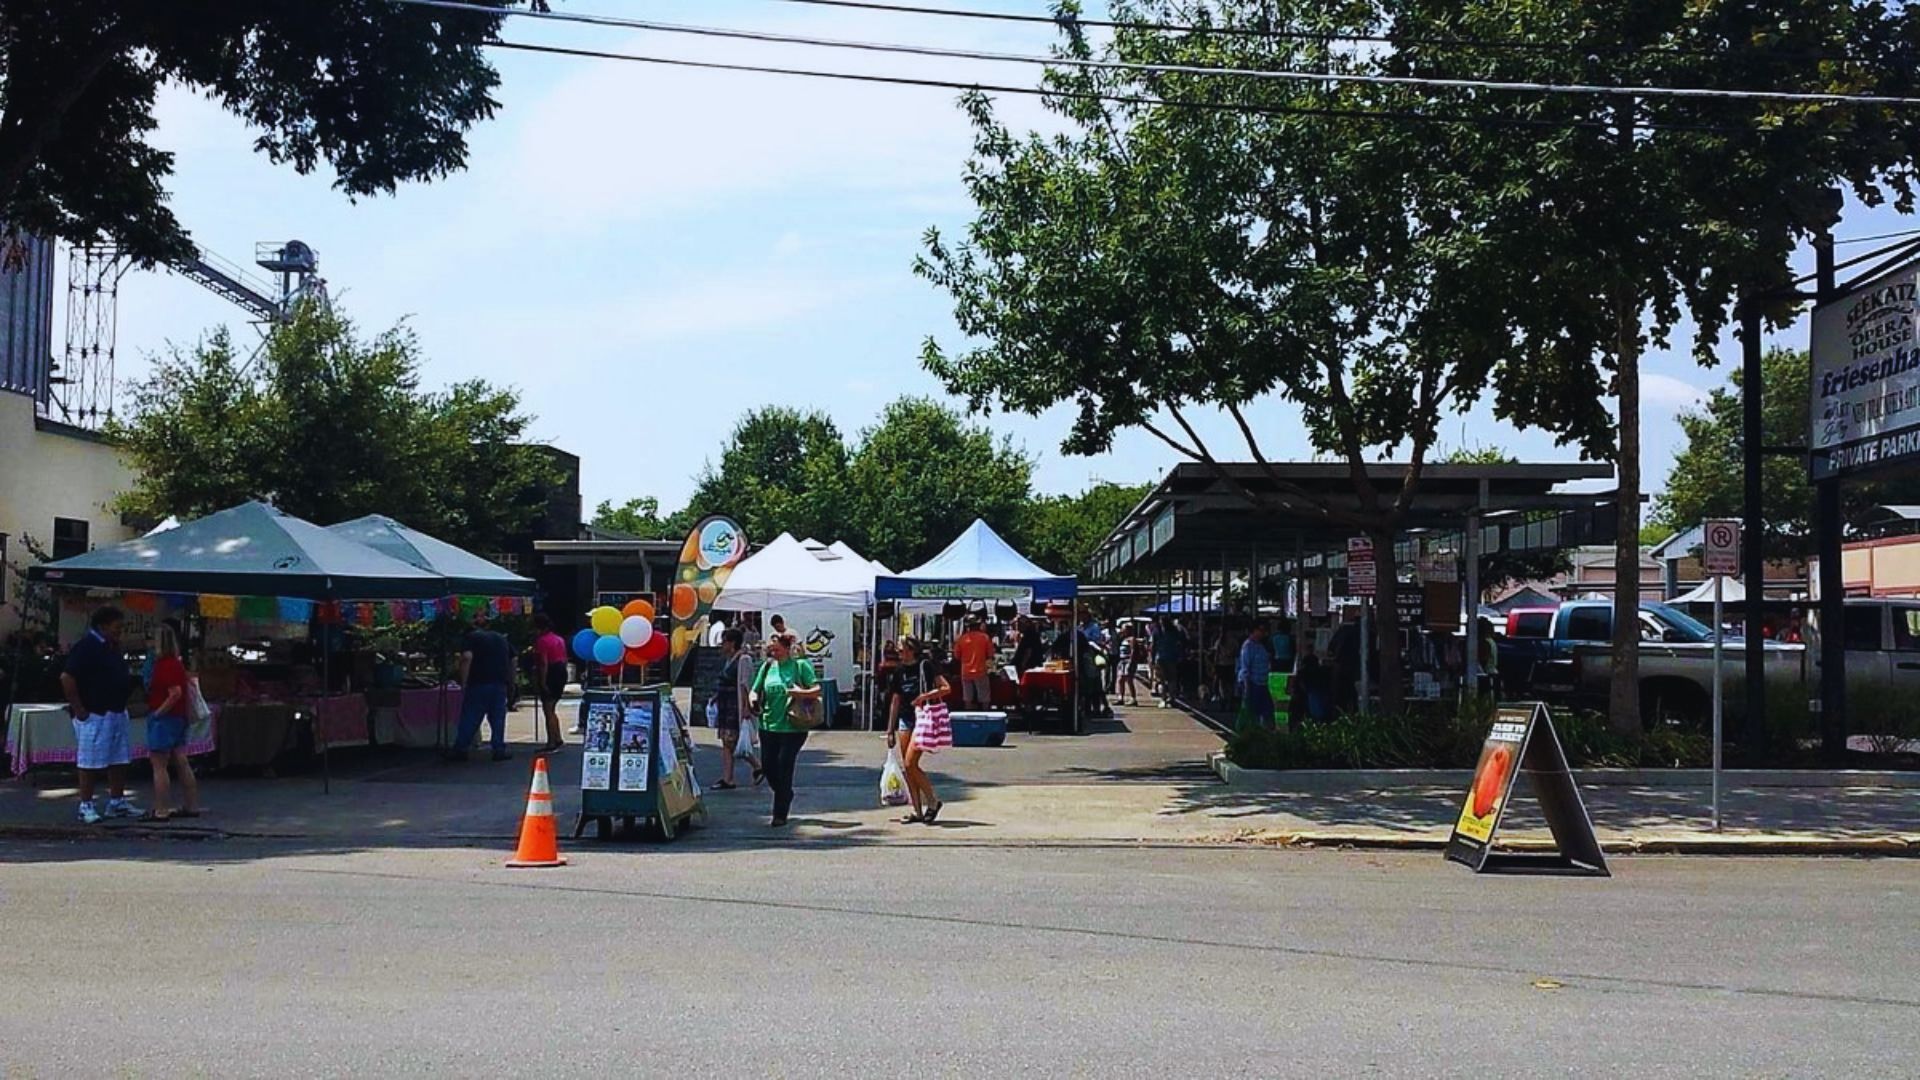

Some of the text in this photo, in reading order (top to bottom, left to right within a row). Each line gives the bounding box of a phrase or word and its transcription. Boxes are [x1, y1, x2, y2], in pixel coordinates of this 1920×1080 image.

[1847, 283, 1917, 329] SEEKATZ
[1852, 315, 1911, 346] OPERA
[1853, 328, 1912, 359] HOUSE
[1828, 440, 1879, 470] PRIVATE
